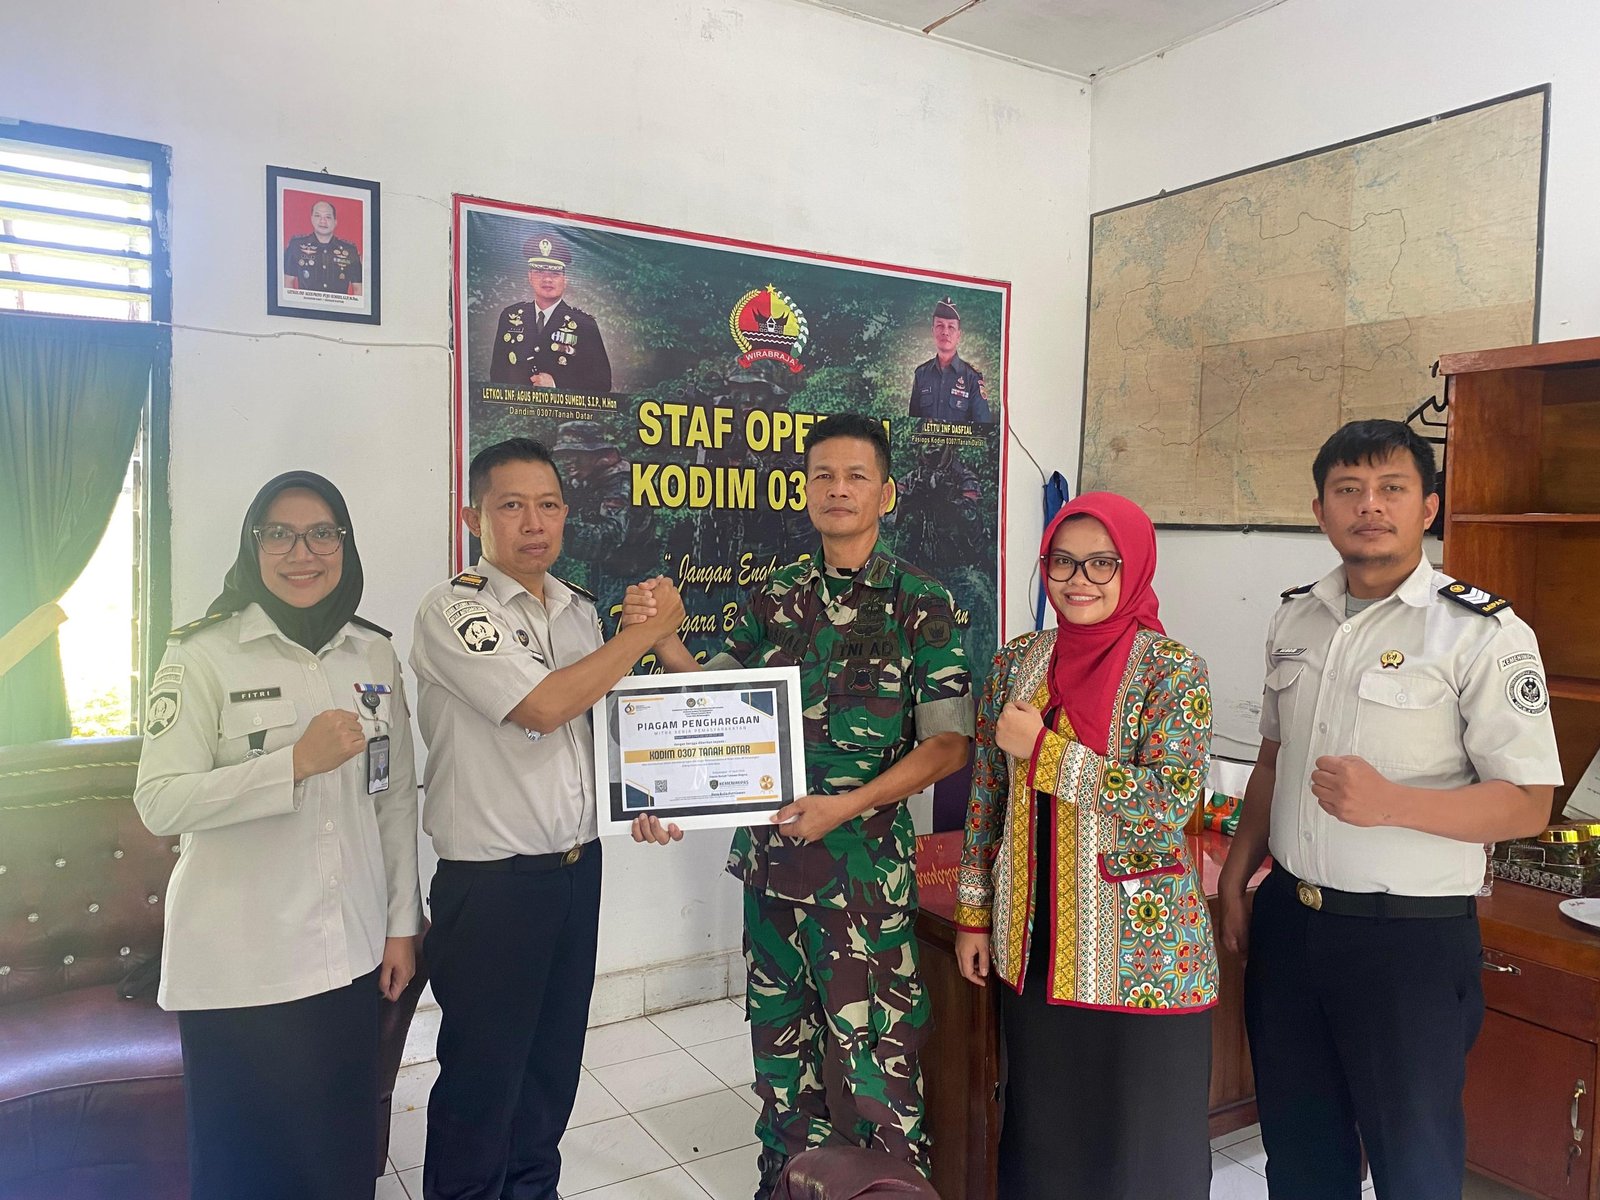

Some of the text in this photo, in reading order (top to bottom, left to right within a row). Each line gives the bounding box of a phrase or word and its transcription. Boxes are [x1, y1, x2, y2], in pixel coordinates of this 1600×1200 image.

[745, 351, 796, 366] WIRABRAJA
[482, 387, 503, 399] LETKOL
[504, 389, 517, 401] INF.
[517, 390, 531, 402] AGUS
[532, 391, 550, 404] PRIYO
[550, 392, 564, 405] PUJO
[565, 393, 587, 408] SUMEDI,
[509, 406, 593, 420] Dandim 0307/Tanah Datar
[638, 401, 735, 449] STAF
[924, 422, 940, 433] LETTU
[941, 423, 951, 433] INF
[632, 463, 756, 510] KODIM
[677, 553, 732, 593] Jangan
[870, 640, 894, 657] AD
[241, 690, 270, 699] FITRI
[637, 715, 760, 731] PIAGAM PENGHARGAAN
[649, 744, 751, 760] KODIM 0307 TANAH DATAR
